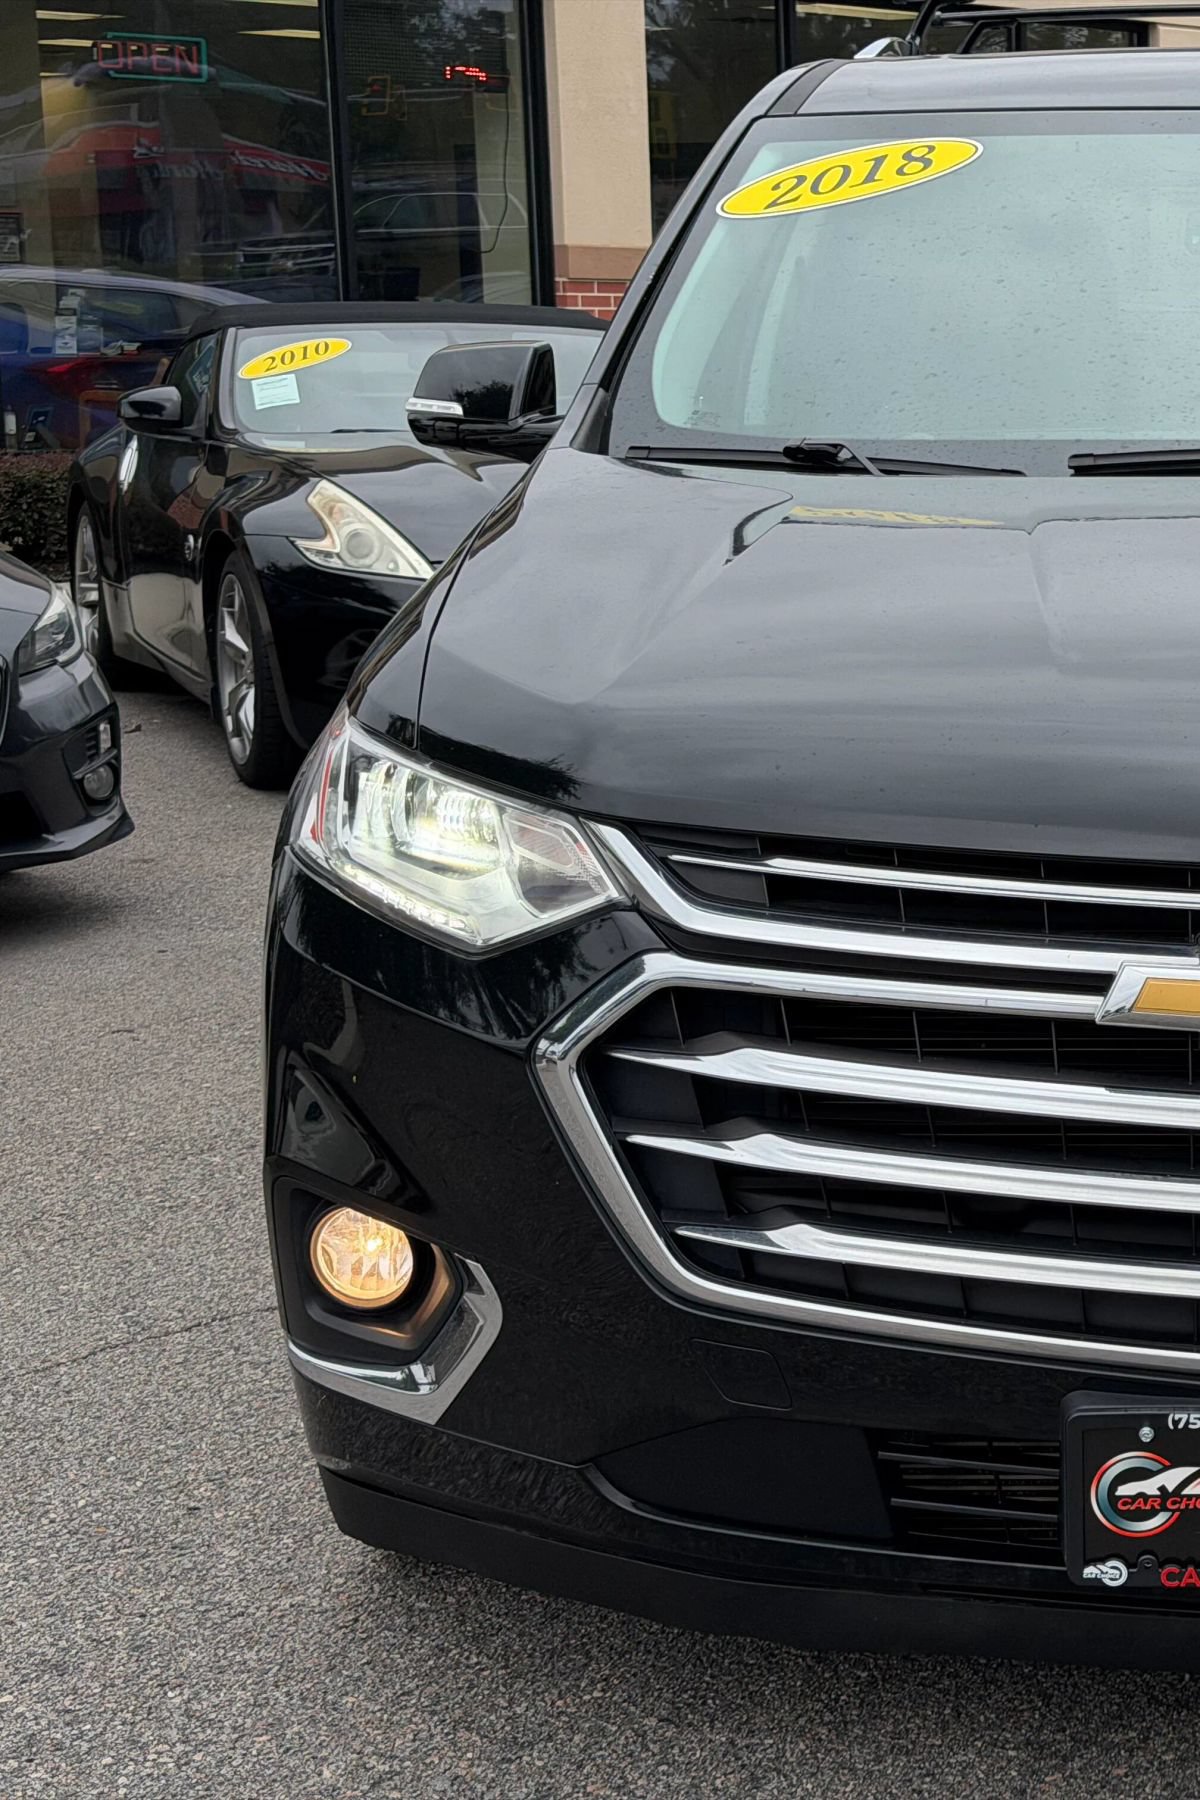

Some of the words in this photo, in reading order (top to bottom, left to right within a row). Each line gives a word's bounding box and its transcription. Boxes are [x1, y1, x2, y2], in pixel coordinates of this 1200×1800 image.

[97, 40, 198, 75] OPEN
[763, 144, 936, 210] 2018
[262, 340, 330, 373] 2010
[1117, 1497, 1162, 1510] CAR
